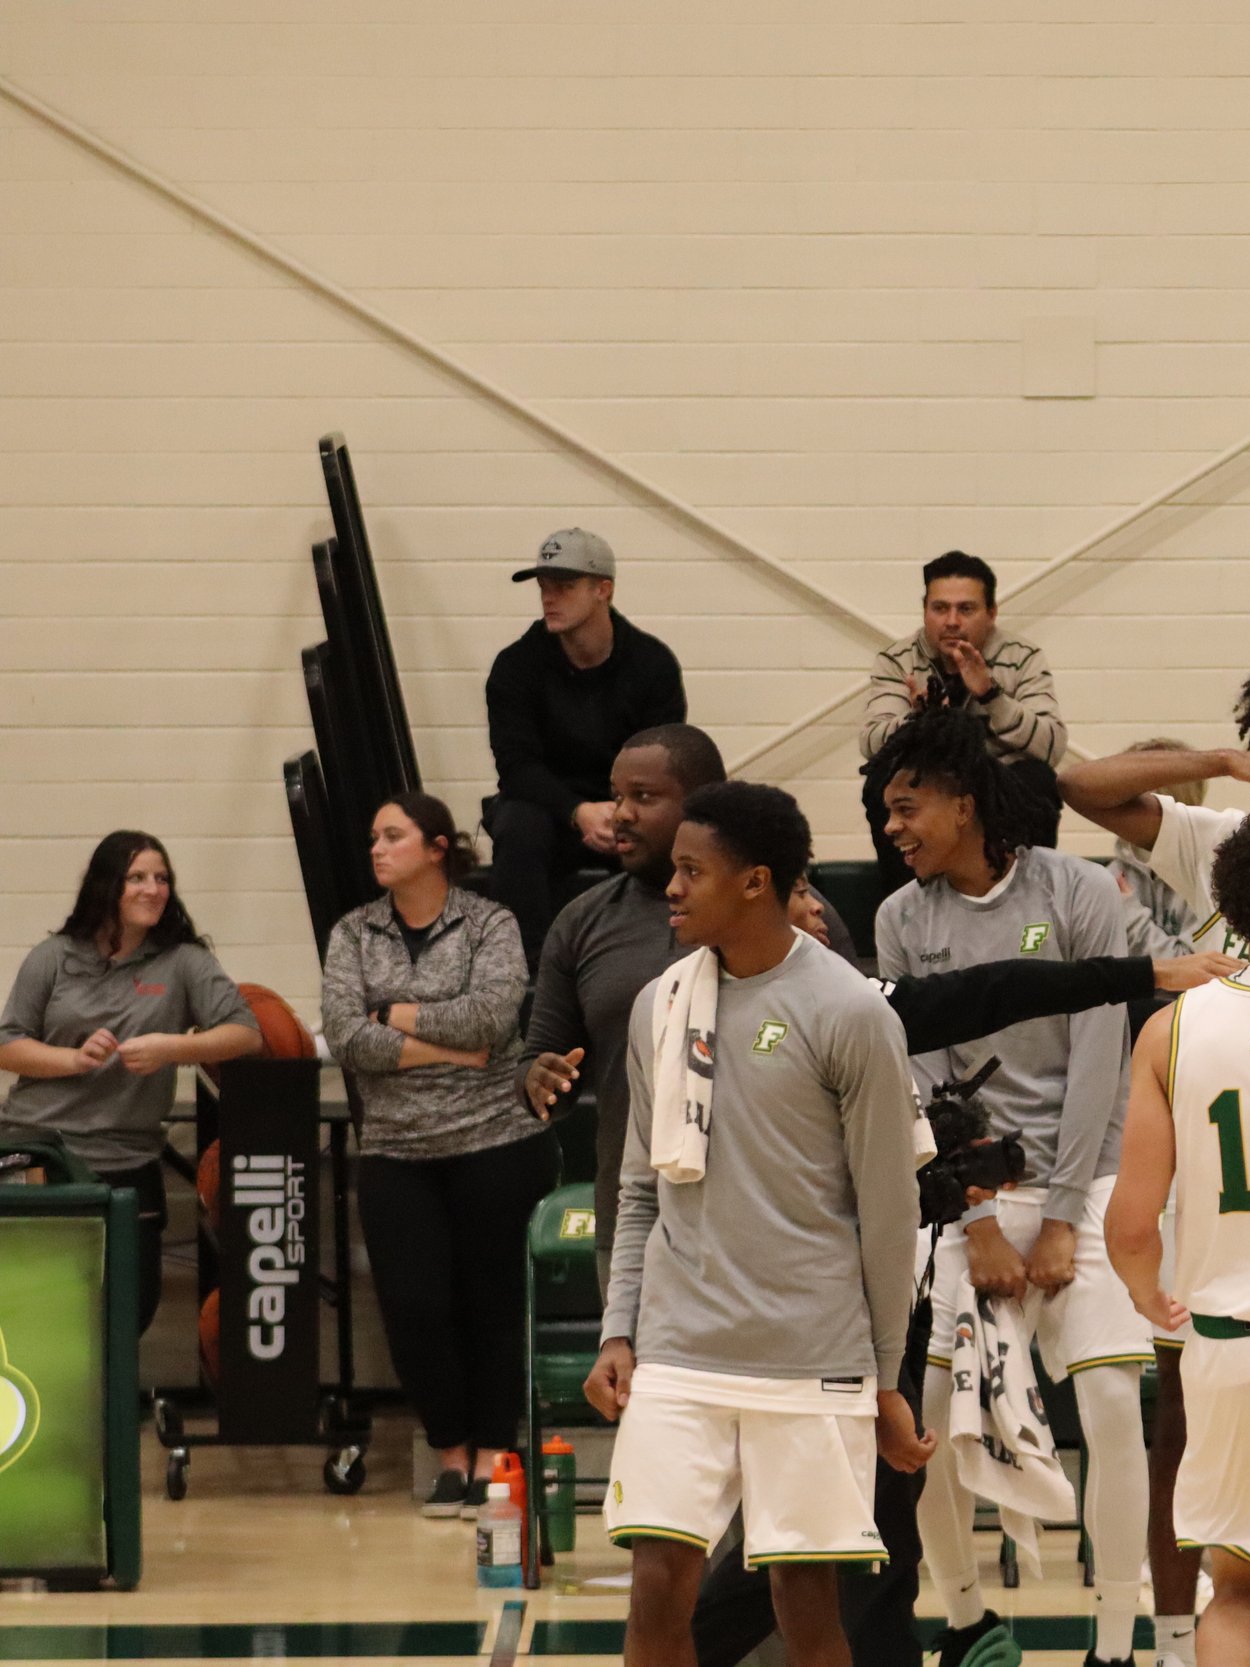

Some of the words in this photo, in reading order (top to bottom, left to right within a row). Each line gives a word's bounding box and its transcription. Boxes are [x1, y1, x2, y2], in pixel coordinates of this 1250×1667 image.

[1020, 923, 1050, 953] F
[752, 1020, 789, 1054] F
[287, 1155, 305, 1264] SPORT
[234, 1155, 299, 1360] capelli
